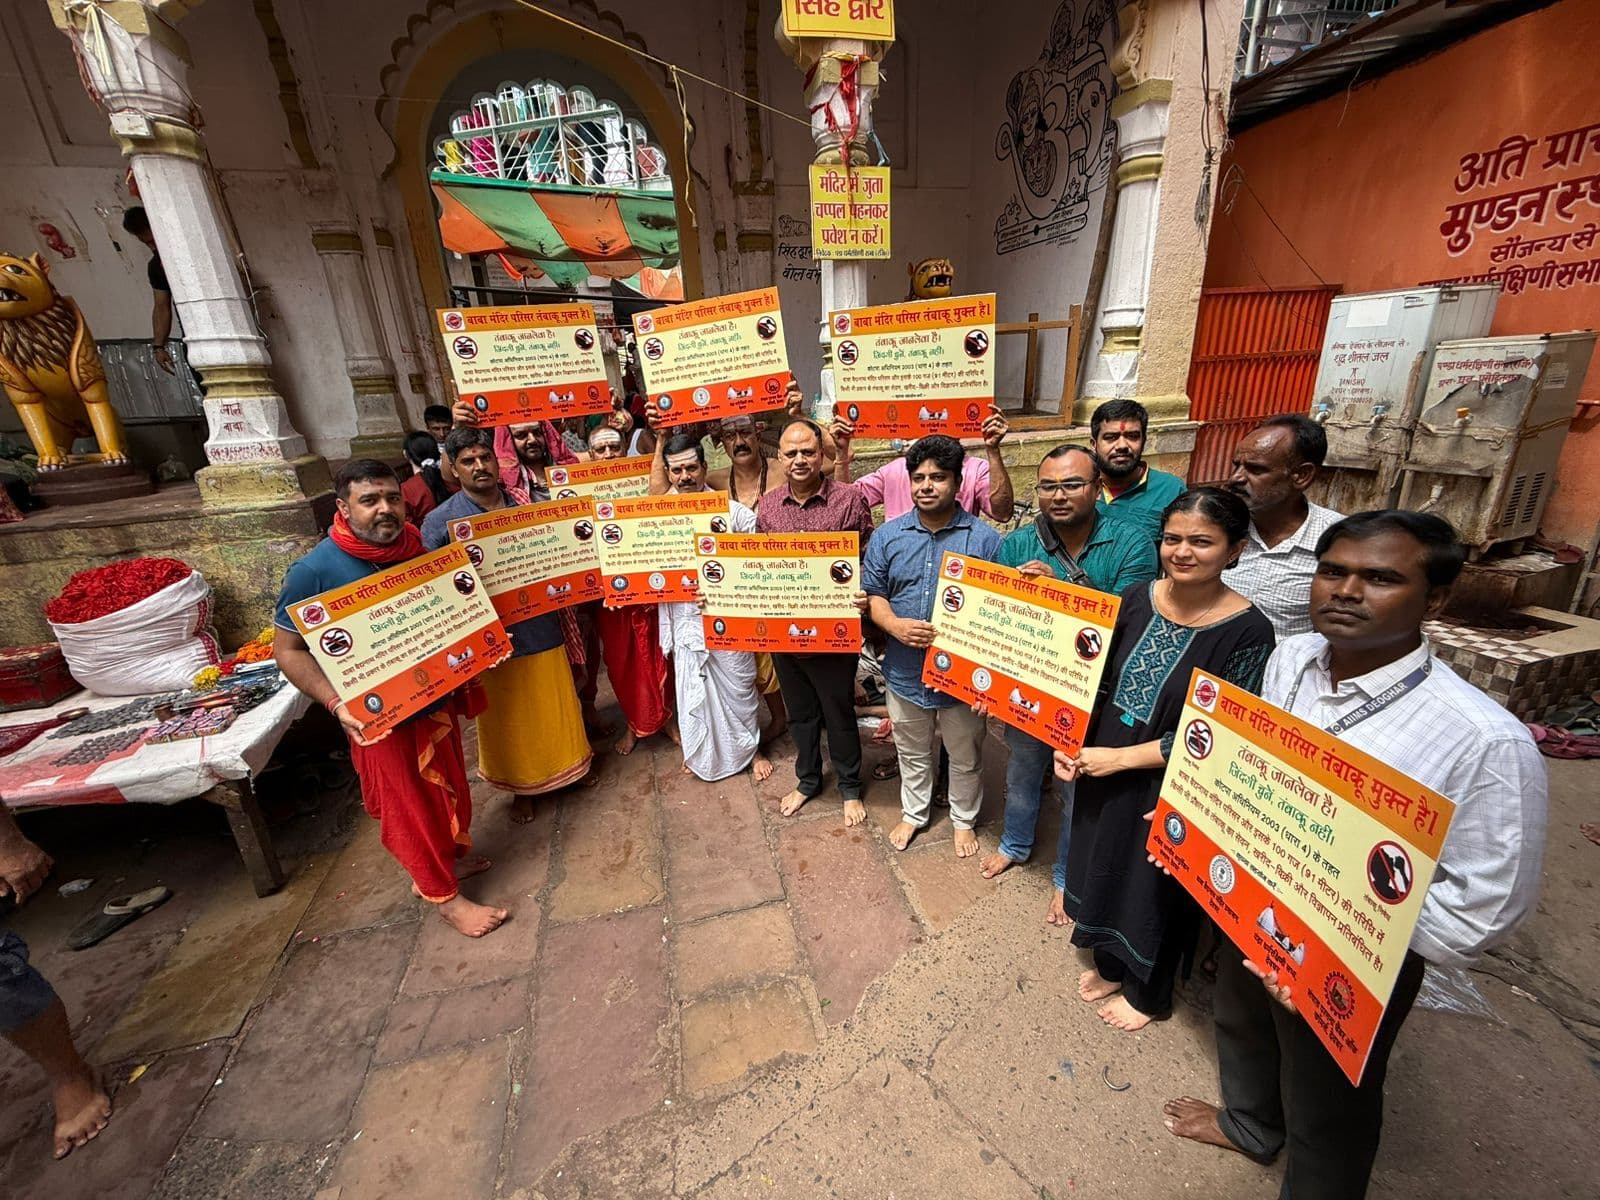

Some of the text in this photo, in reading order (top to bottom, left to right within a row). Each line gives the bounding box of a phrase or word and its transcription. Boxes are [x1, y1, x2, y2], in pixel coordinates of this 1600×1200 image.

[1454, 123, 1600, 192] अति प्रा
[819, 169, 883, 199] मंदिर में जुता
[815, 203, 888, 219] चप्पल पहनकर
[821, 224, 883, 244] प्रवेश न करें।
[1440, 184, 1559, 253] मुण्डन
[1572, 222, 1600, 249] से
[853, 300, 990, 327] बाबा मंदिर परिसर तंबाकू मुक्त है।
[1372, 352, 1389, 363] जल
[327, 549, 463, 610] बाबा मंदिर परिसर तंबाकू मुक्त है।
[1343, 682, 1408, 727] AIIMS DEOGHAR
[1220, 695, 1438, 836] बाबा मंदिर परिसर तंबाकू मुक्त है।
[1237, 748, 1337, 819] तंबाकू जानलेवा है।
[1260, 813, 1279, 832] 2003
[1280, 826, 1300, 848] (धारा
[1301, 844, 1310, 858] 4)
[1312, 850, 1321, 862] के
[1321, 858, 1340, 879] तहत
[1277, 797, 1308, 832] तंबाकू
[1309, 819, 1334, 846] नहीं।
[1272, 842, 1285, 858] 100
[1287, 853, 1300, 870] गज
[1300, 863, 1315, 882] (91
[1317, 877, 1339, 905] मीटर)
[1340, 898, 1352, 915] की
[1353, 909, 1376, 936] परिधि
[1376, 929, 1385, 945] में
